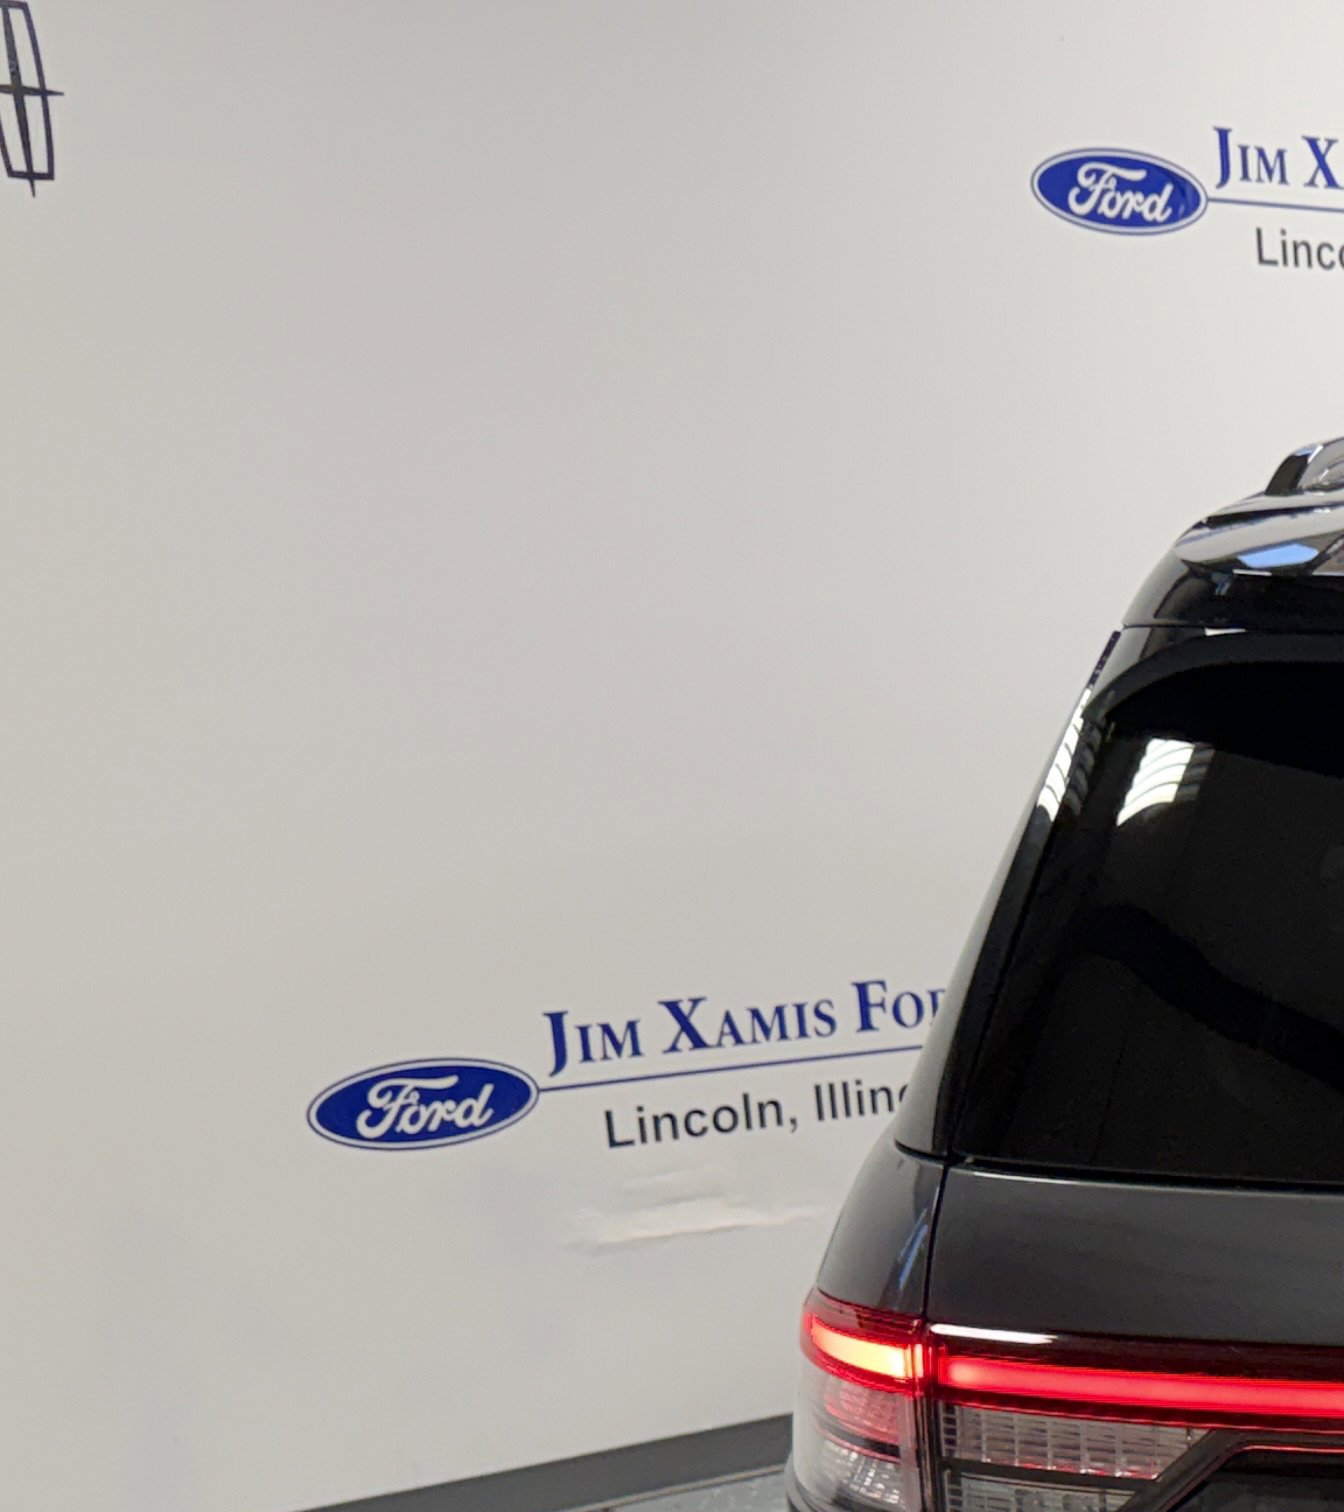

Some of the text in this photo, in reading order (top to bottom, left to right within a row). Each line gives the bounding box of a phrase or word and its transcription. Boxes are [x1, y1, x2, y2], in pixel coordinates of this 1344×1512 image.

[1213, 126, 1290, 189] JIM
[1068, 161, 1174, 224] Ford
[543, 979, 947, 1077] JIM XAMIS FO
[355, 1074, 496, 1139] Ford
[605, 1077, 908, 1150] Lincoln, Illin
